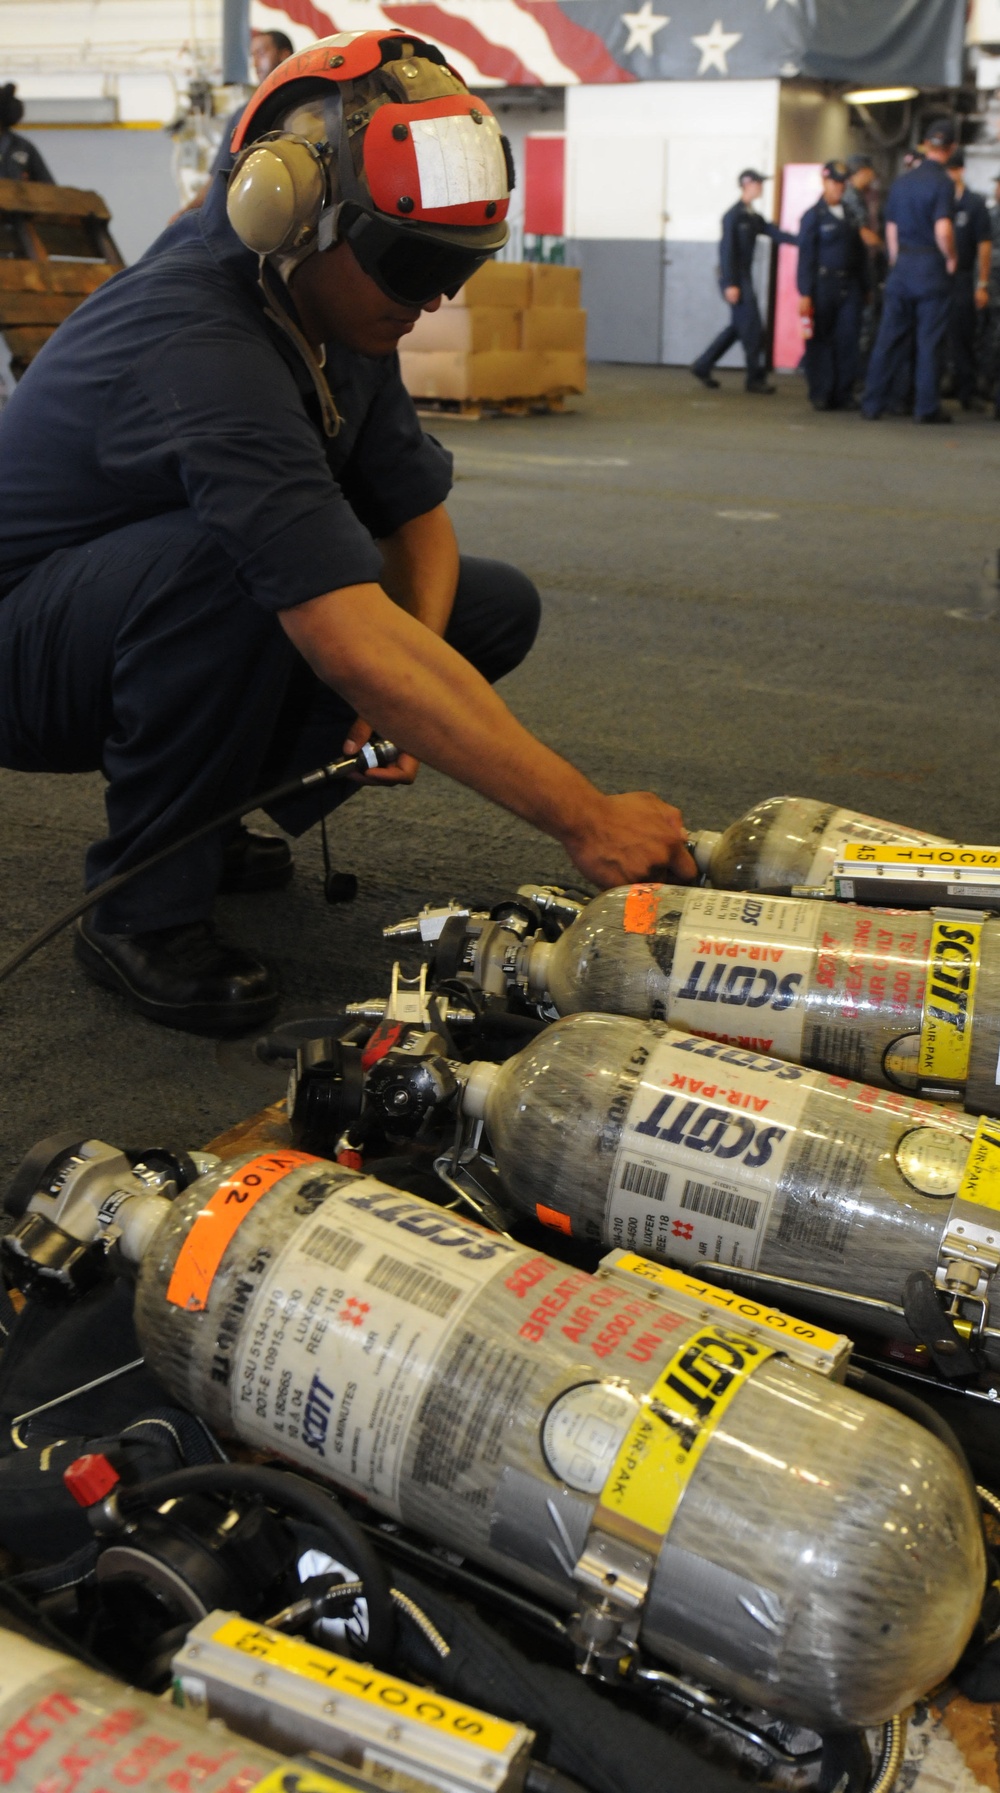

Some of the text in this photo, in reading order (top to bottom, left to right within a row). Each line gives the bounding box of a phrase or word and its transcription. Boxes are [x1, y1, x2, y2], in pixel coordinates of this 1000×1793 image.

[856, 845, 876, 861] 4.5
[897, 851, 998, 866] SCOTT
[697, 940, 784, 962] AIR-PAK
[676, 961, 803, 1011] SCOTT
[928, 924, 975, 1033] SCOTT
[924, 1021, 938, 1068] AIR-PAK
[668, 1073, 769, 1112] AIR-PAK
[634, 1094, 787, 1168] SCOTT
[966, 1143, 988, 1190] AIR-PAK
[346, 1191, 517, 1262] SCOTT
[643, 1214, 656, 1247] LUXFER
[659, 1215, 670, 1233] 118
[698, 1241, 708, 1257] AIR
[324, 1288, 346, 1314] 118
[504, 1256, 558, 1299] SCOTT
[211, 1280, 256, 1387] MINUTE
[293, 1285, 329, 1344] LUXFER
[562, 1305, 600, 1344] AIR
[683, 1280, 816, 1341] SCOTT
[240, 1289, 284, 1404] TC-SU 5134-310
[255, 1289, 303, 1419] DOT-E 10915-4500
[362, 1330, 379, 1355] AIR
[590, 1313, 636, 1360] 4500
[626, 1331, 663, 1363] UN
[292, 1389, 305, 1408] 04
[337, 1381, 359, 1440] MINUTES
[649, 1326, 759, 1454] SCOTT
[301, 1374, 335, 1458] SCOTT
[610, 1421, 655, 1497] AIR-PAK
[306, 1660, 485, 1739] SCOTT
